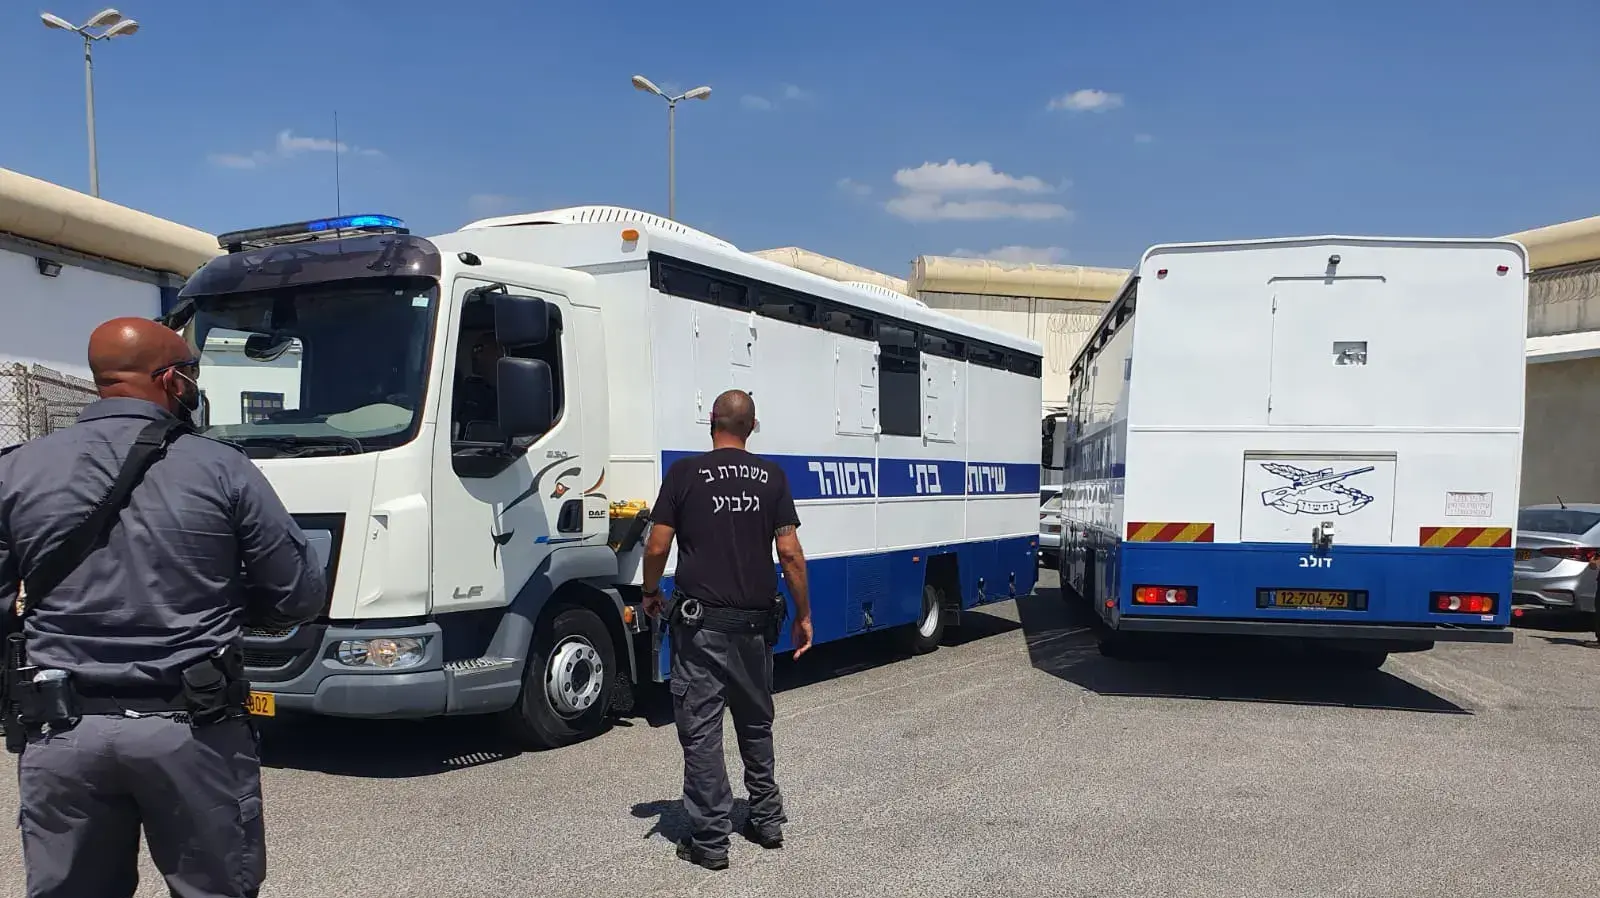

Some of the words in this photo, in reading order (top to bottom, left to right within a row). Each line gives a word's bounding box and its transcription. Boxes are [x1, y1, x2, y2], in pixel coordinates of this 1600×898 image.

[717, 464, 769, 484] משמרת
[808, 461, 875, 496] הסוהר
[909, 464, 942, 494] בתי
[968, 465, 1006, 493] שירות
[712, 490, 760, 514] גלבוע
[1301, 501, 1335, 512] נחשון
[588, 510, 606, 519] DAF
[1299, 554, 1333, 568] דולב
[453, 585, 484, 600] LF
